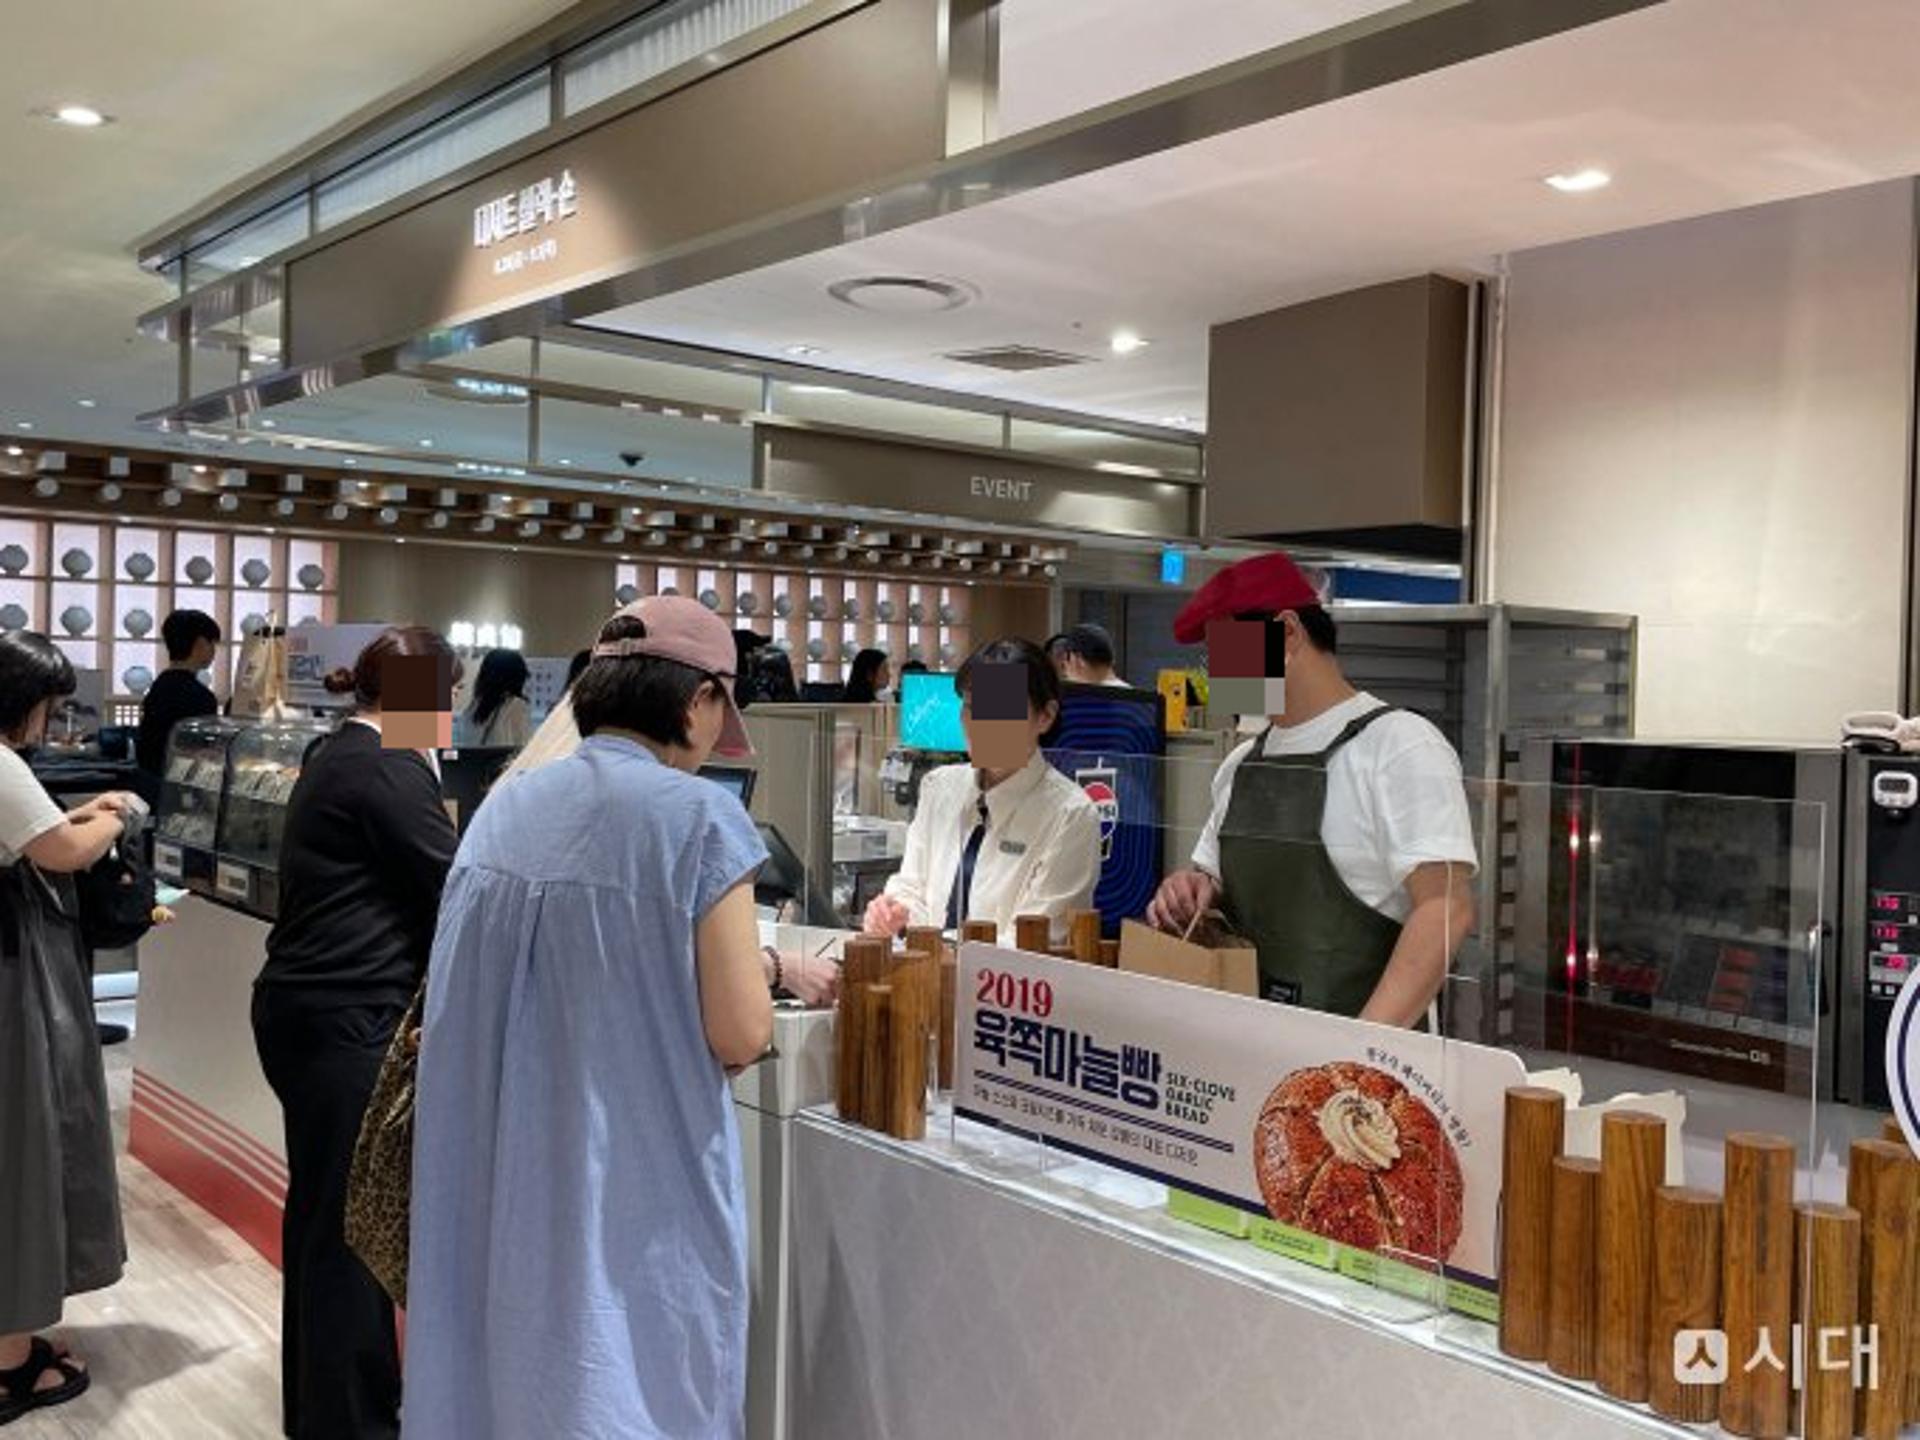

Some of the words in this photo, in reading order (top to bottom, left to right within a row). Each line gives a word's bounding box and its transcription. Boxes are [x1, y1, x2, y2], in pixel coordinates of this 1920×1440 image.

[969, 476, 1034, 500] EVENT
[976, 967, 1053, 1018] 2019
[973, 1008, 1161, 1111] 육쪽마늘빵
[1165, 1085, 1213, 1112] GARLIC
[1166, 1071, 1235, 1103] SIX-CLOVE
[1165, 1100, 1209, 1125] BREAD
